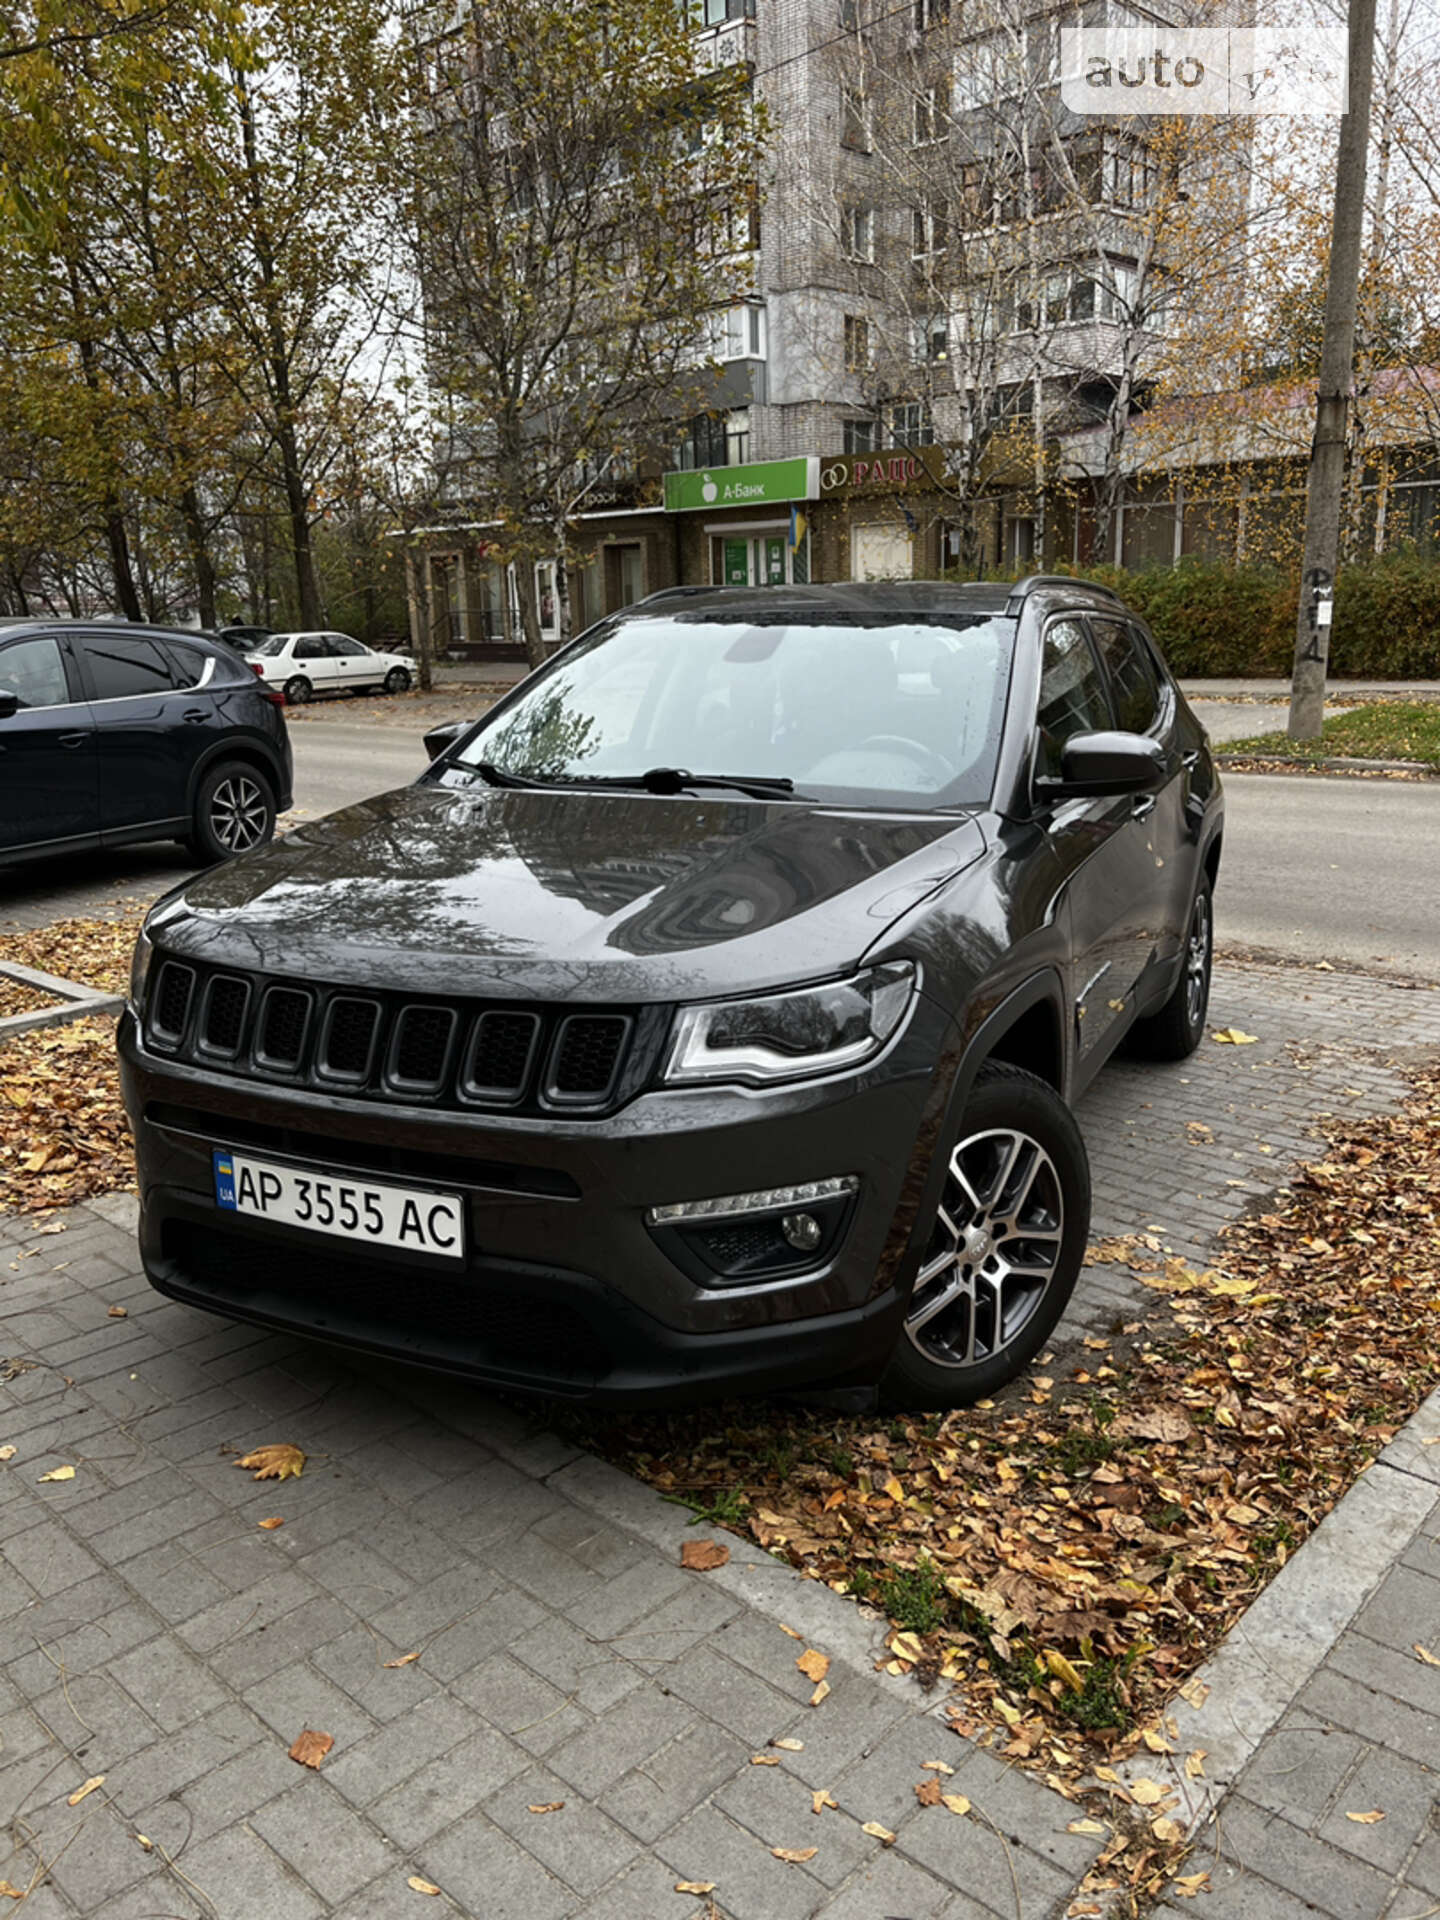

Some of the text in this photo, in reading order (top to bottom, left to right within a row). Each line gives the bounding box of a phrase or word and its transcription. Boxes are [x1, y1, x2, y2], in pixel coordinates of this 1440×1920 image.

[852, 456, 925, 486] РАЦС
[723, 483, 765, 499] А-Банк
[219, 1187, 235, 1203] UA
[238, 1167, 456, 1248] AP 3555 AC
